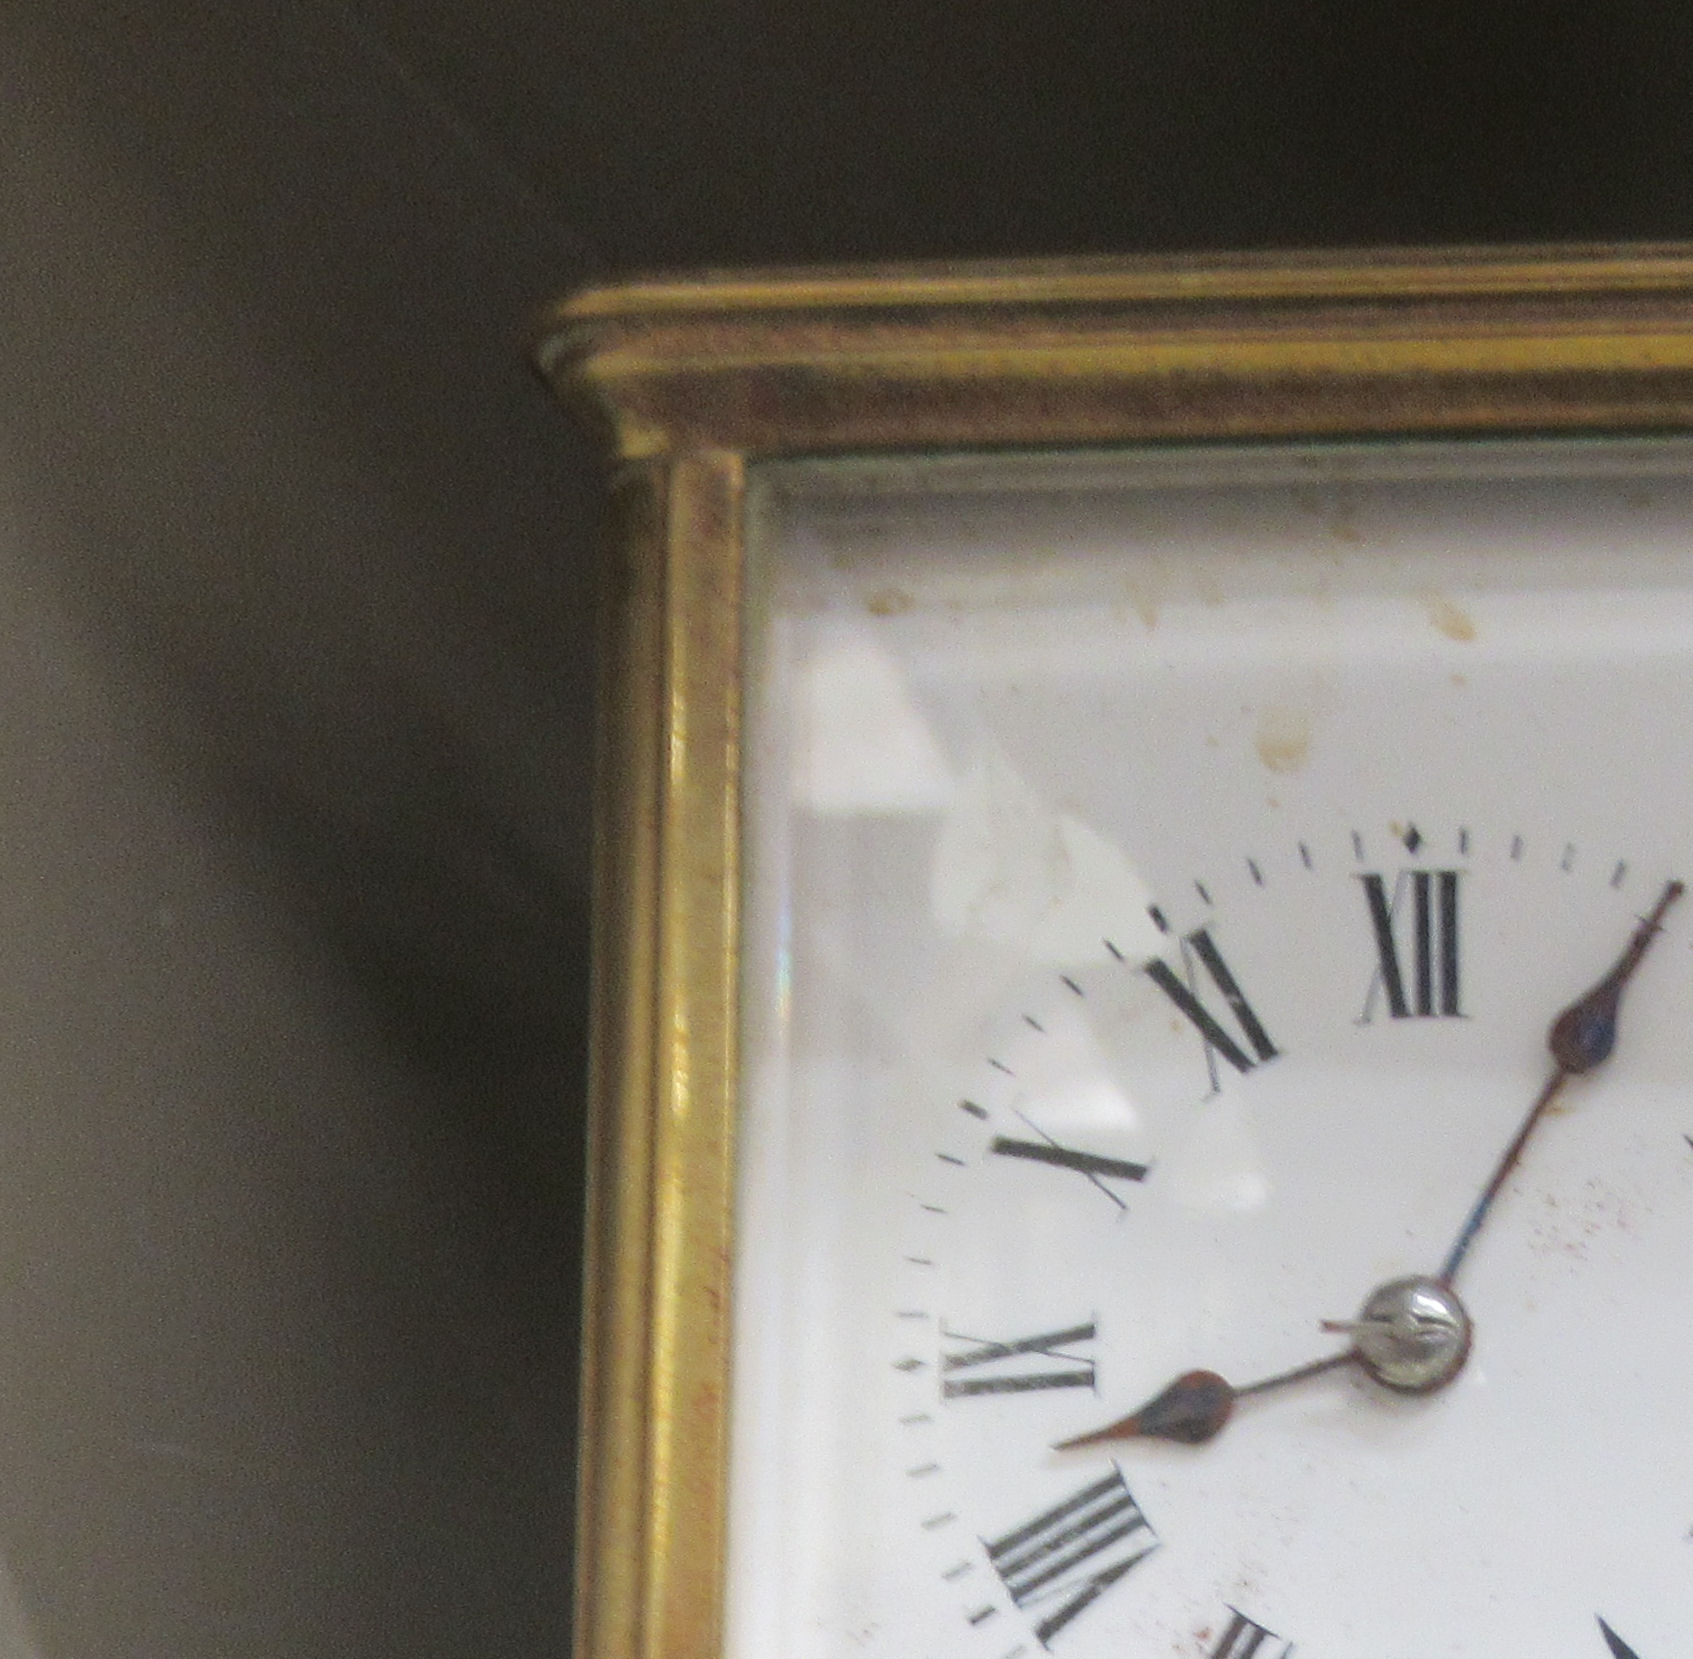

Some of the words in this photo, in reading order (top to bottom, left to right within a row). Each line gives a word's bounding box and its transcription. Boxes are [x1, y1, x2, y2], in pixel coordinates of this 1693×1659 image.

[1145, 927, 1284, 1095] XI
[1355, 869, 1475, 1025] XII
[989, 1110, 1152, 1215] X
[939, 1311, 1100, 1402] IX
